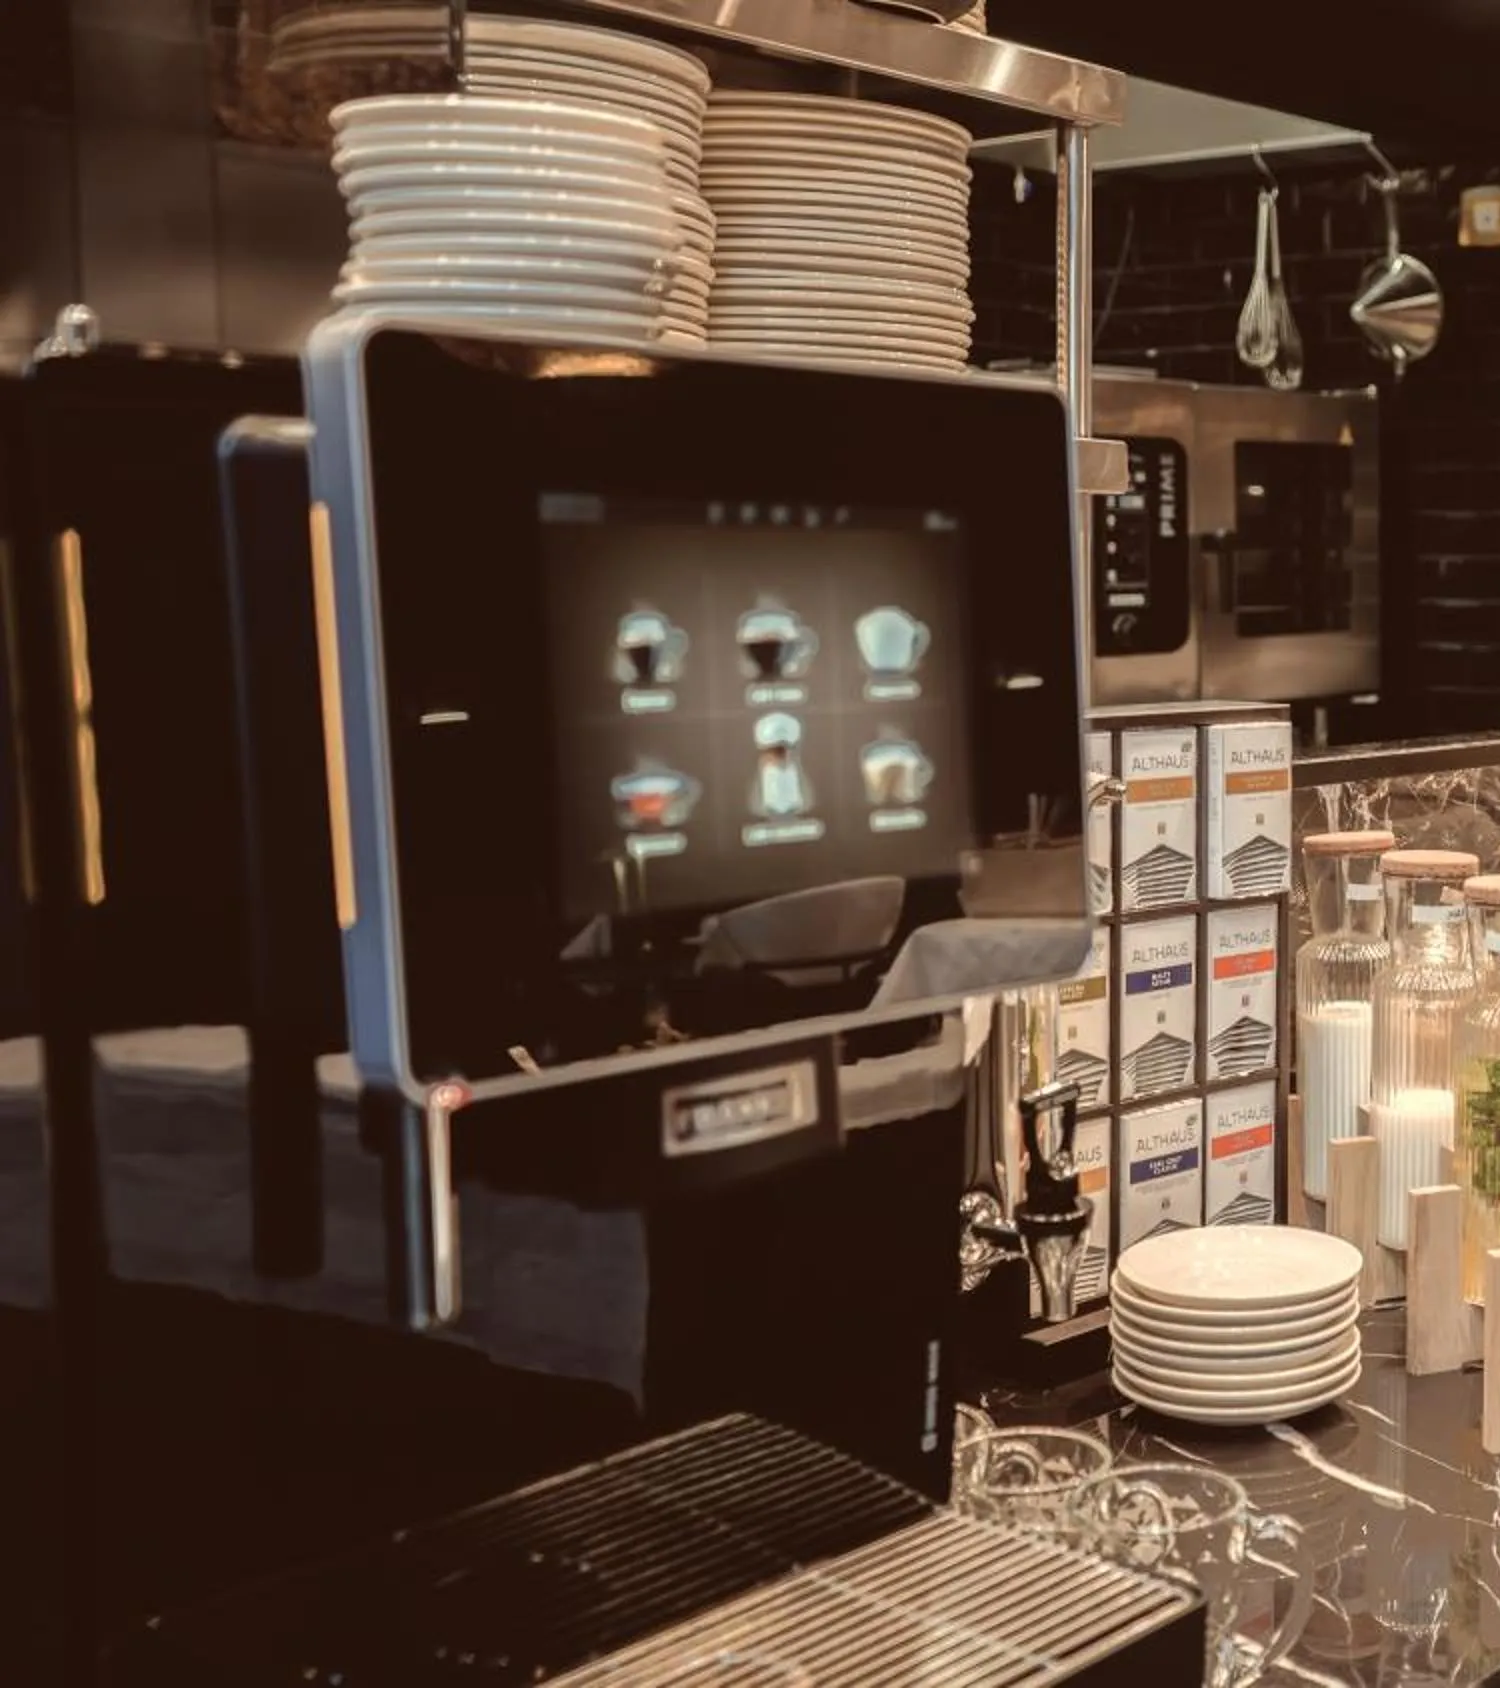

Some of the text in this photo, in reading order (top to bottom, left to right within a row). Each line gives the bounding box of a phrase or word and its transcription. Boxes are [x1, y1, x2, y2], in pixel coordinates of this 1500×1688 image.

[1132, 754, 1189, 772] ALTHAUS
[1231, 749, 1285, 765] ALTHAUS
[1219, 930, 1271, 949] ALTHAUS
[1132, 942, 1189, 963] ALTHAUS
[1217, 1105, 1270, 1127] ALTHAUS
[1136, 1126, 1195, 1153] ALTHAUS
